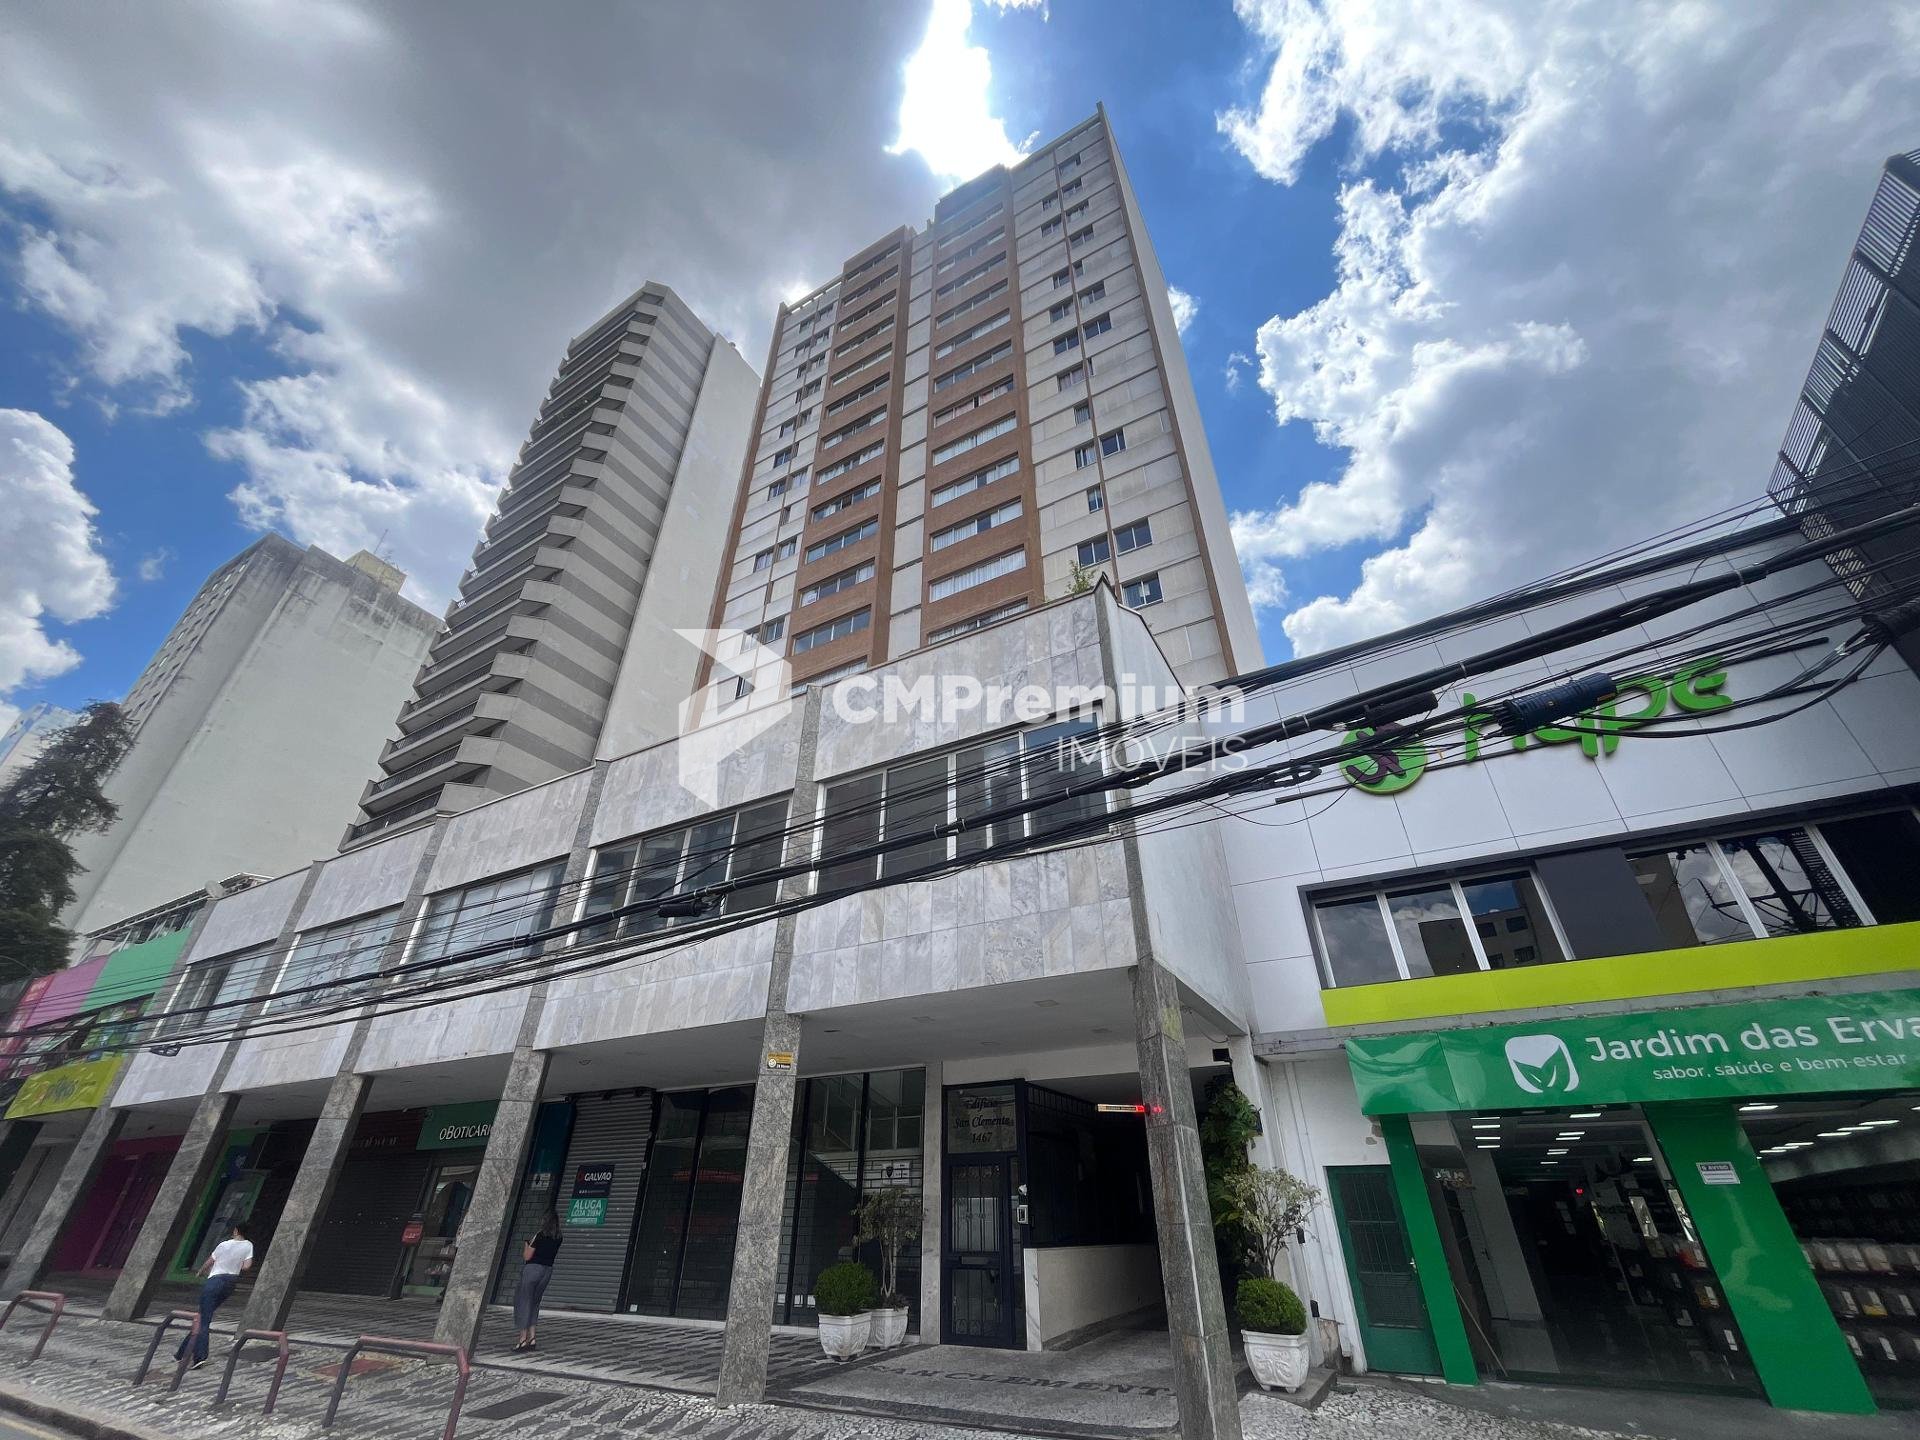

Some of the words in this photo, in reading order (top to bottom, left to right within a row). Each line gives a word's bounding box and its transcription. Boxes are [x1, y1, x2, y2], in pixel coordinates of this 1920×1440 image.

[1585, 1028, 1729, 1062] Jardim
[1740, 1023, 1819, 1051] das
[1716, 1060, 1773, 1077] saúde
[1779, 1062, 1792, 1072] e
[1797, 1053, 1906, 1071] bem-estar
[573, 1199, 602, 1209] ALUGA
[945, 1372, 1177, 1397] CLEMENT
